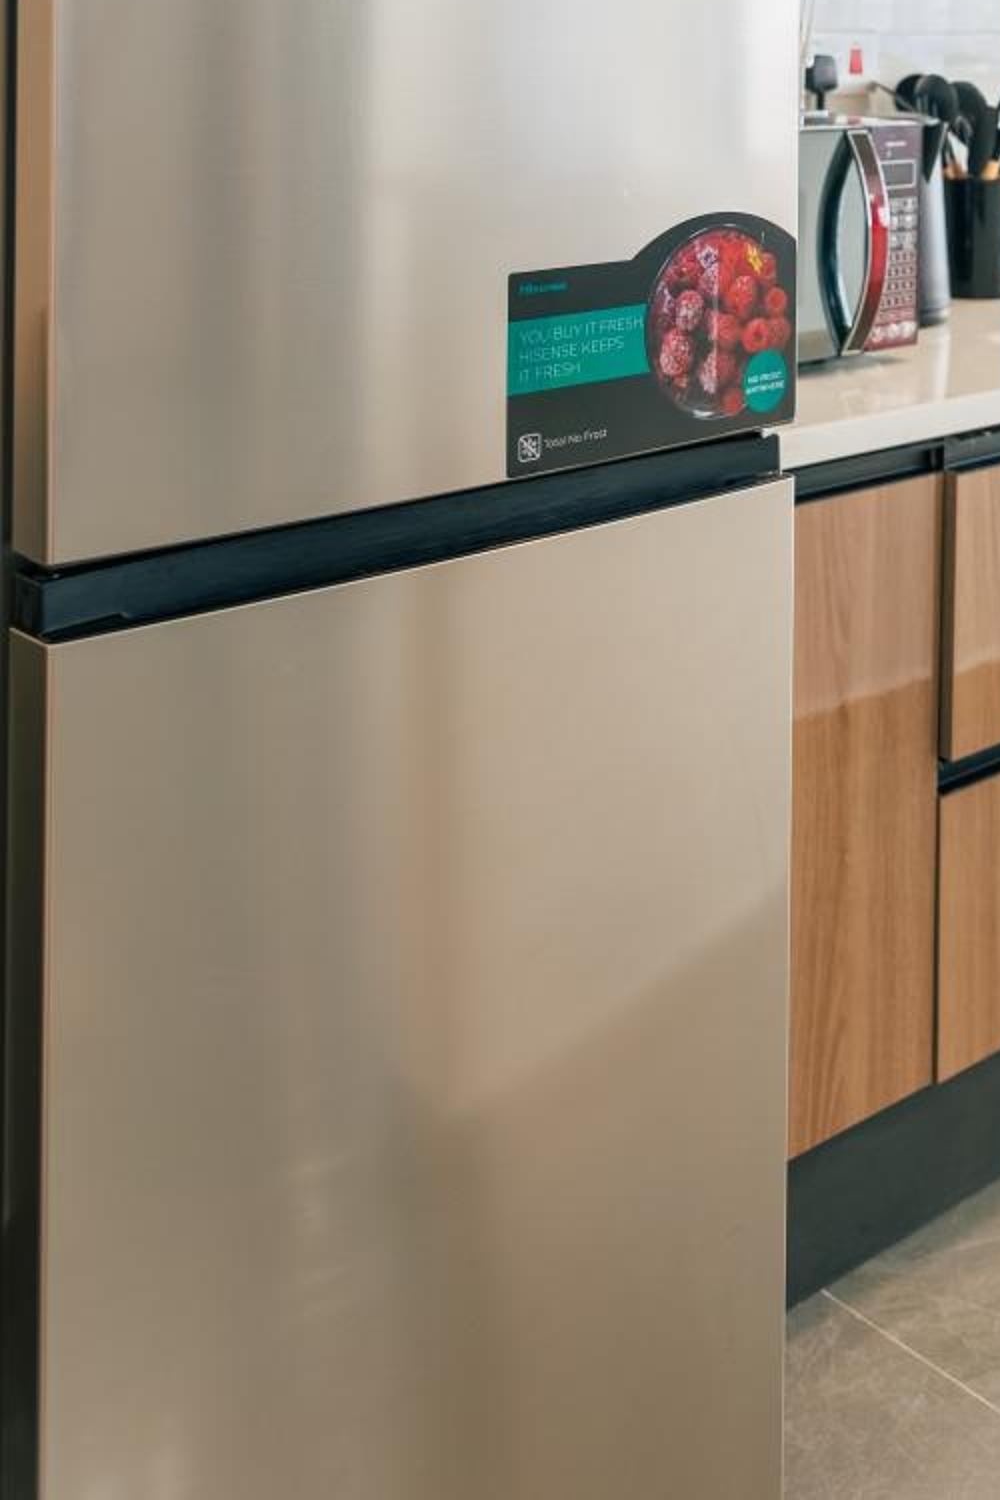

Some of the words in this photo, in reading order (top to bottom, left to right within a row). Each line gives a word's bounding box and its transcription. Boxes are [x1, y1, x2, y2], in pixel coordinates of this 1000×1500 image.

[553, 323, 581, 340] BUY
[585, 321, 599, 336] IT
[600, 315, 643, 333] FRESH
[519, 342, 577, 362] HISENSE
[581, 335, 625, 355] KEEPS
[535, 362, 581, 380] FRESH
